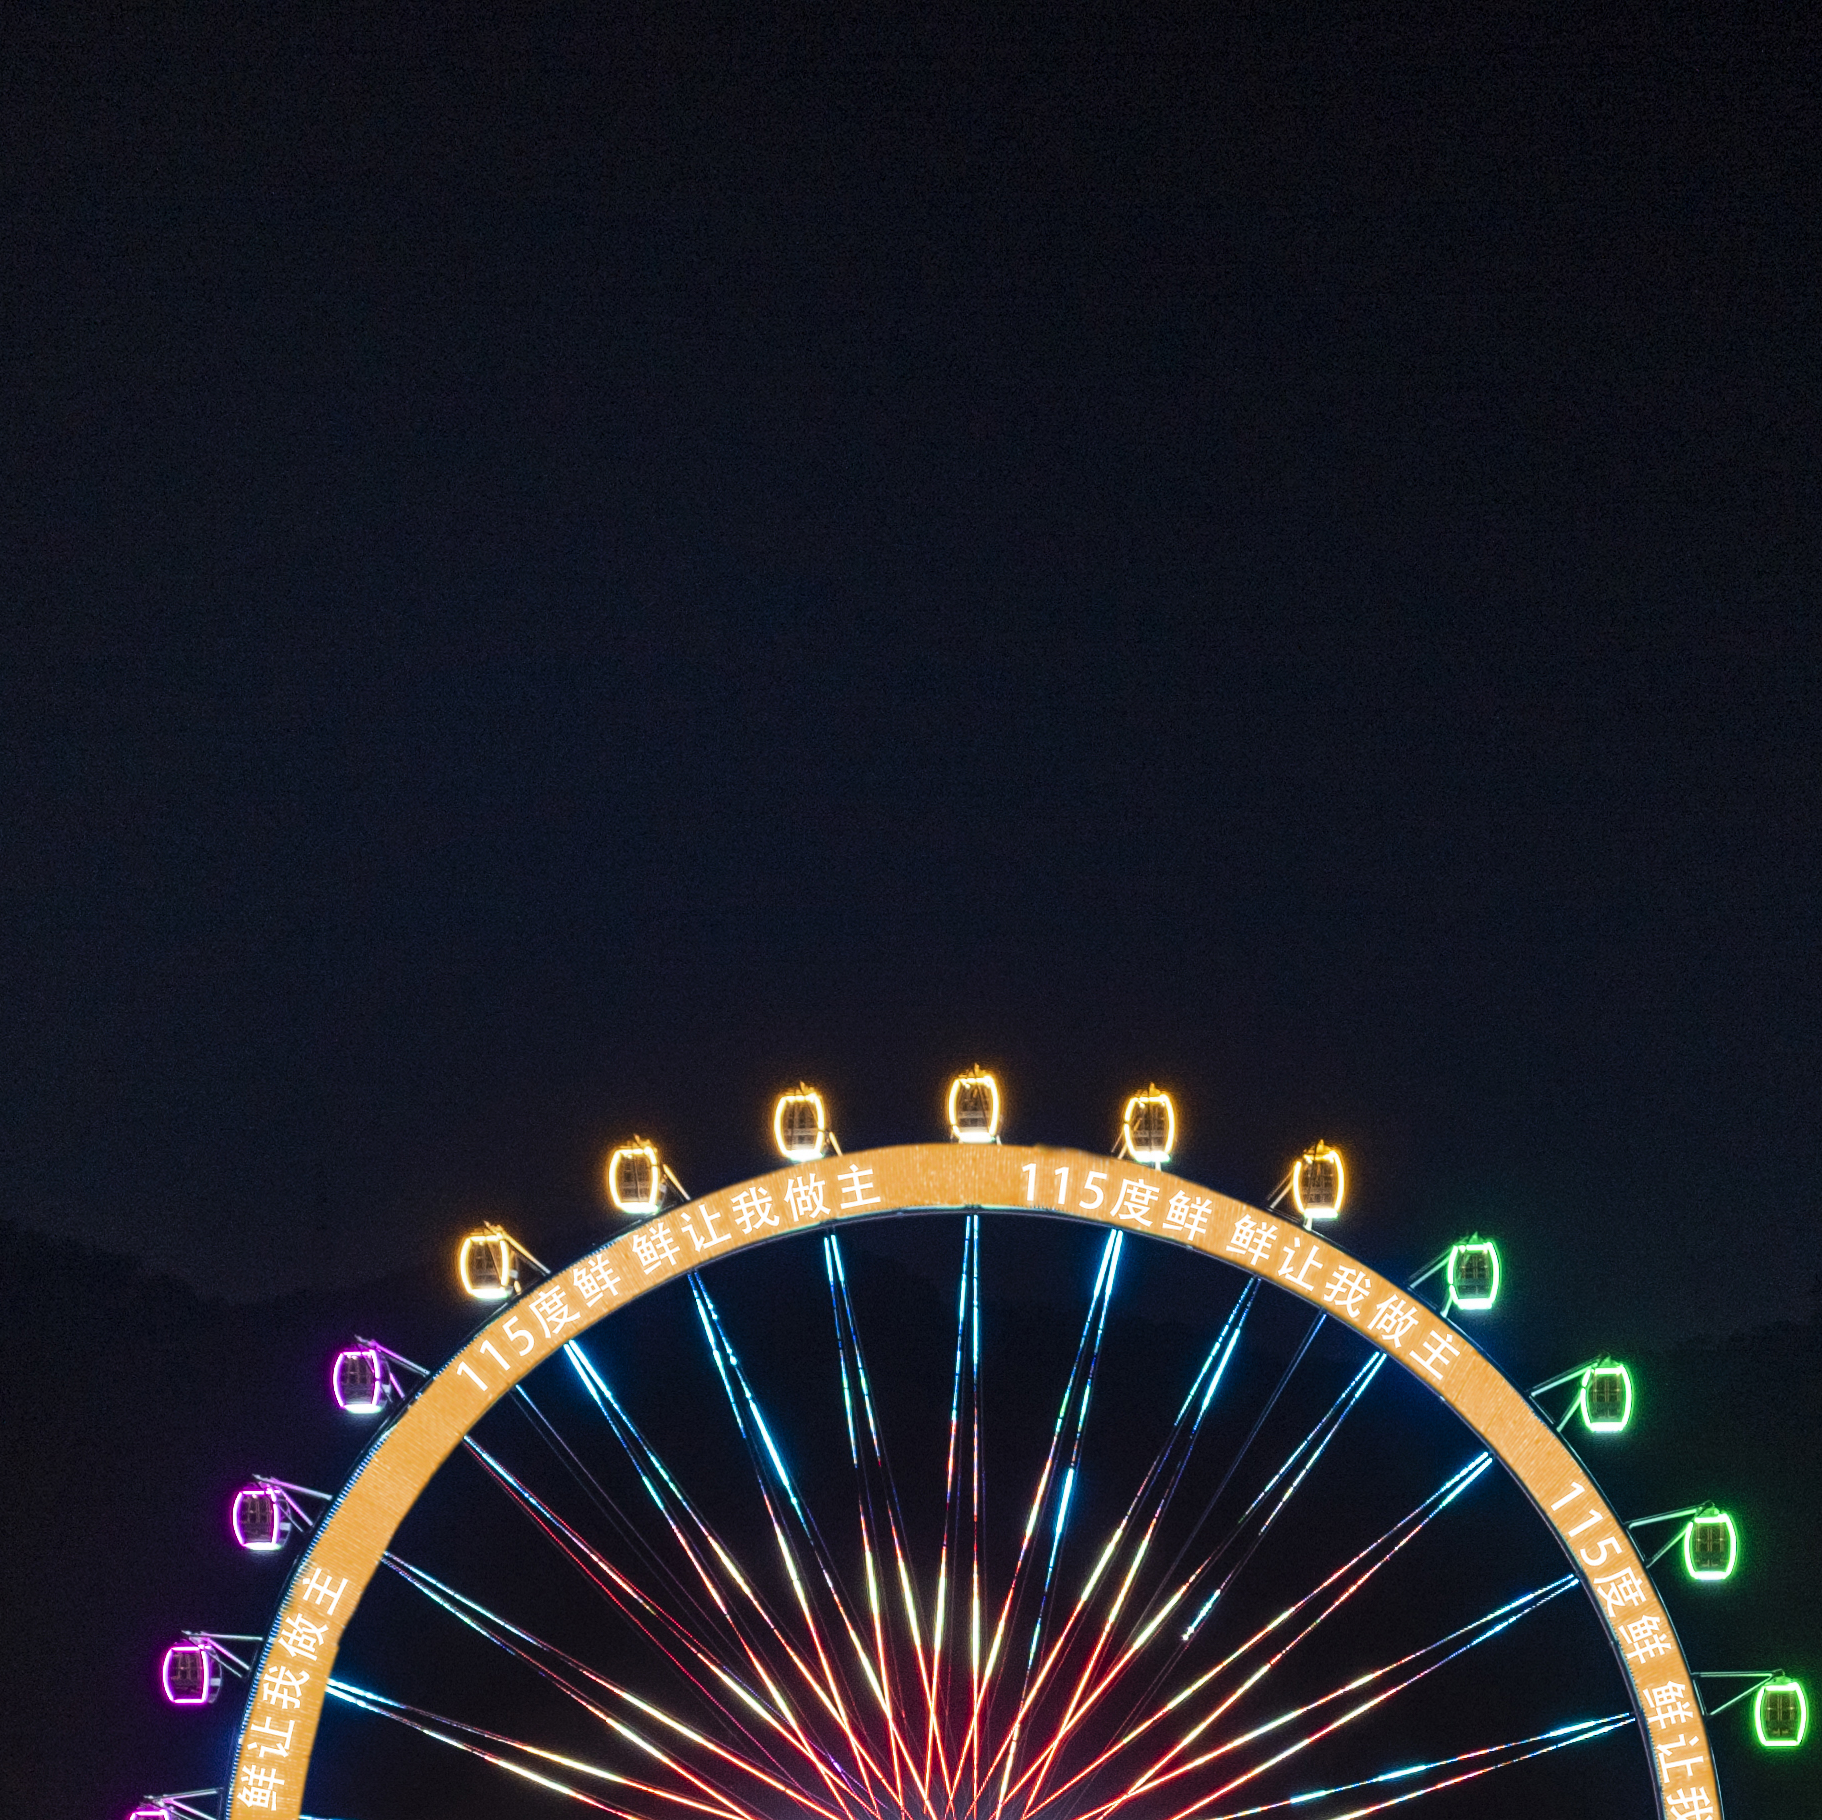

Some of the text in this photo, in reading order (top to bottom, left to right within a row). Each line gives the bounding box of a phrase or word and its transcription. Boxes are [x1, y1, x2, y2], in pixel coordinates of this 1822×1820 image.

[457, 1163, 880, 1392] 115度鲜 鲜让我做主
[1022, 1162, 1461, 1381] 115度鲜 鲜让我做主
[1551, 1482, 1671, 1663] 115度鲜
[237, 1568, 348, 1810] 鲜让我做主
